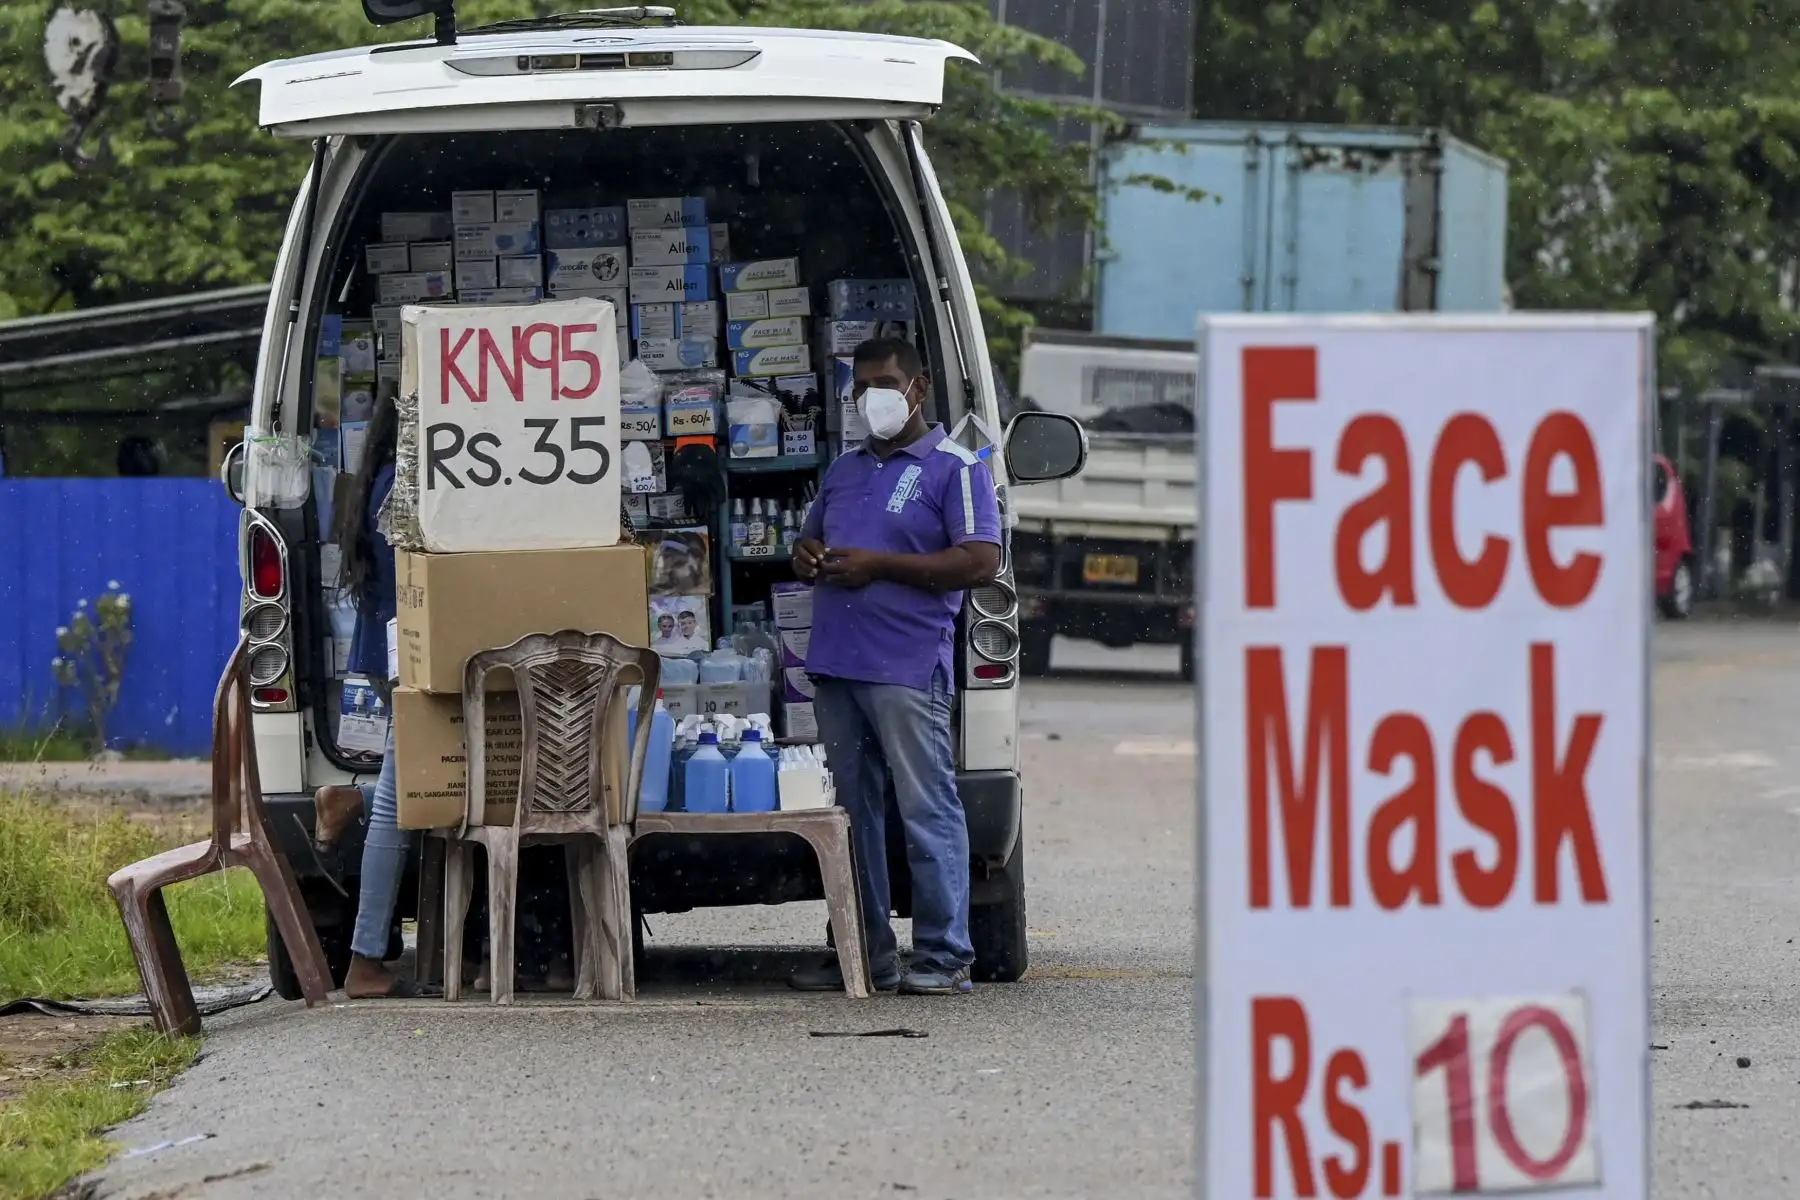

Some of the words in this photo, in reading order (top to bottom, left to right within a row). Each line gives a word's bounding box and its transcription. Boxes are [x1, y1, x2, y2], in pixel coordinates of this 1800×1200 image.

[663, 210, 695, 224] Allen
[668, 241, 700, 254] Allen
[665, 278, 698, 291] Allen
[440, 322, 602, 404] KN95
[1241, 346, 1605, 611] Face
[750, 546, 768, 555] 220
[704, 701, 717, 712] 10
[1244, 641, 1609, 912] Mask
